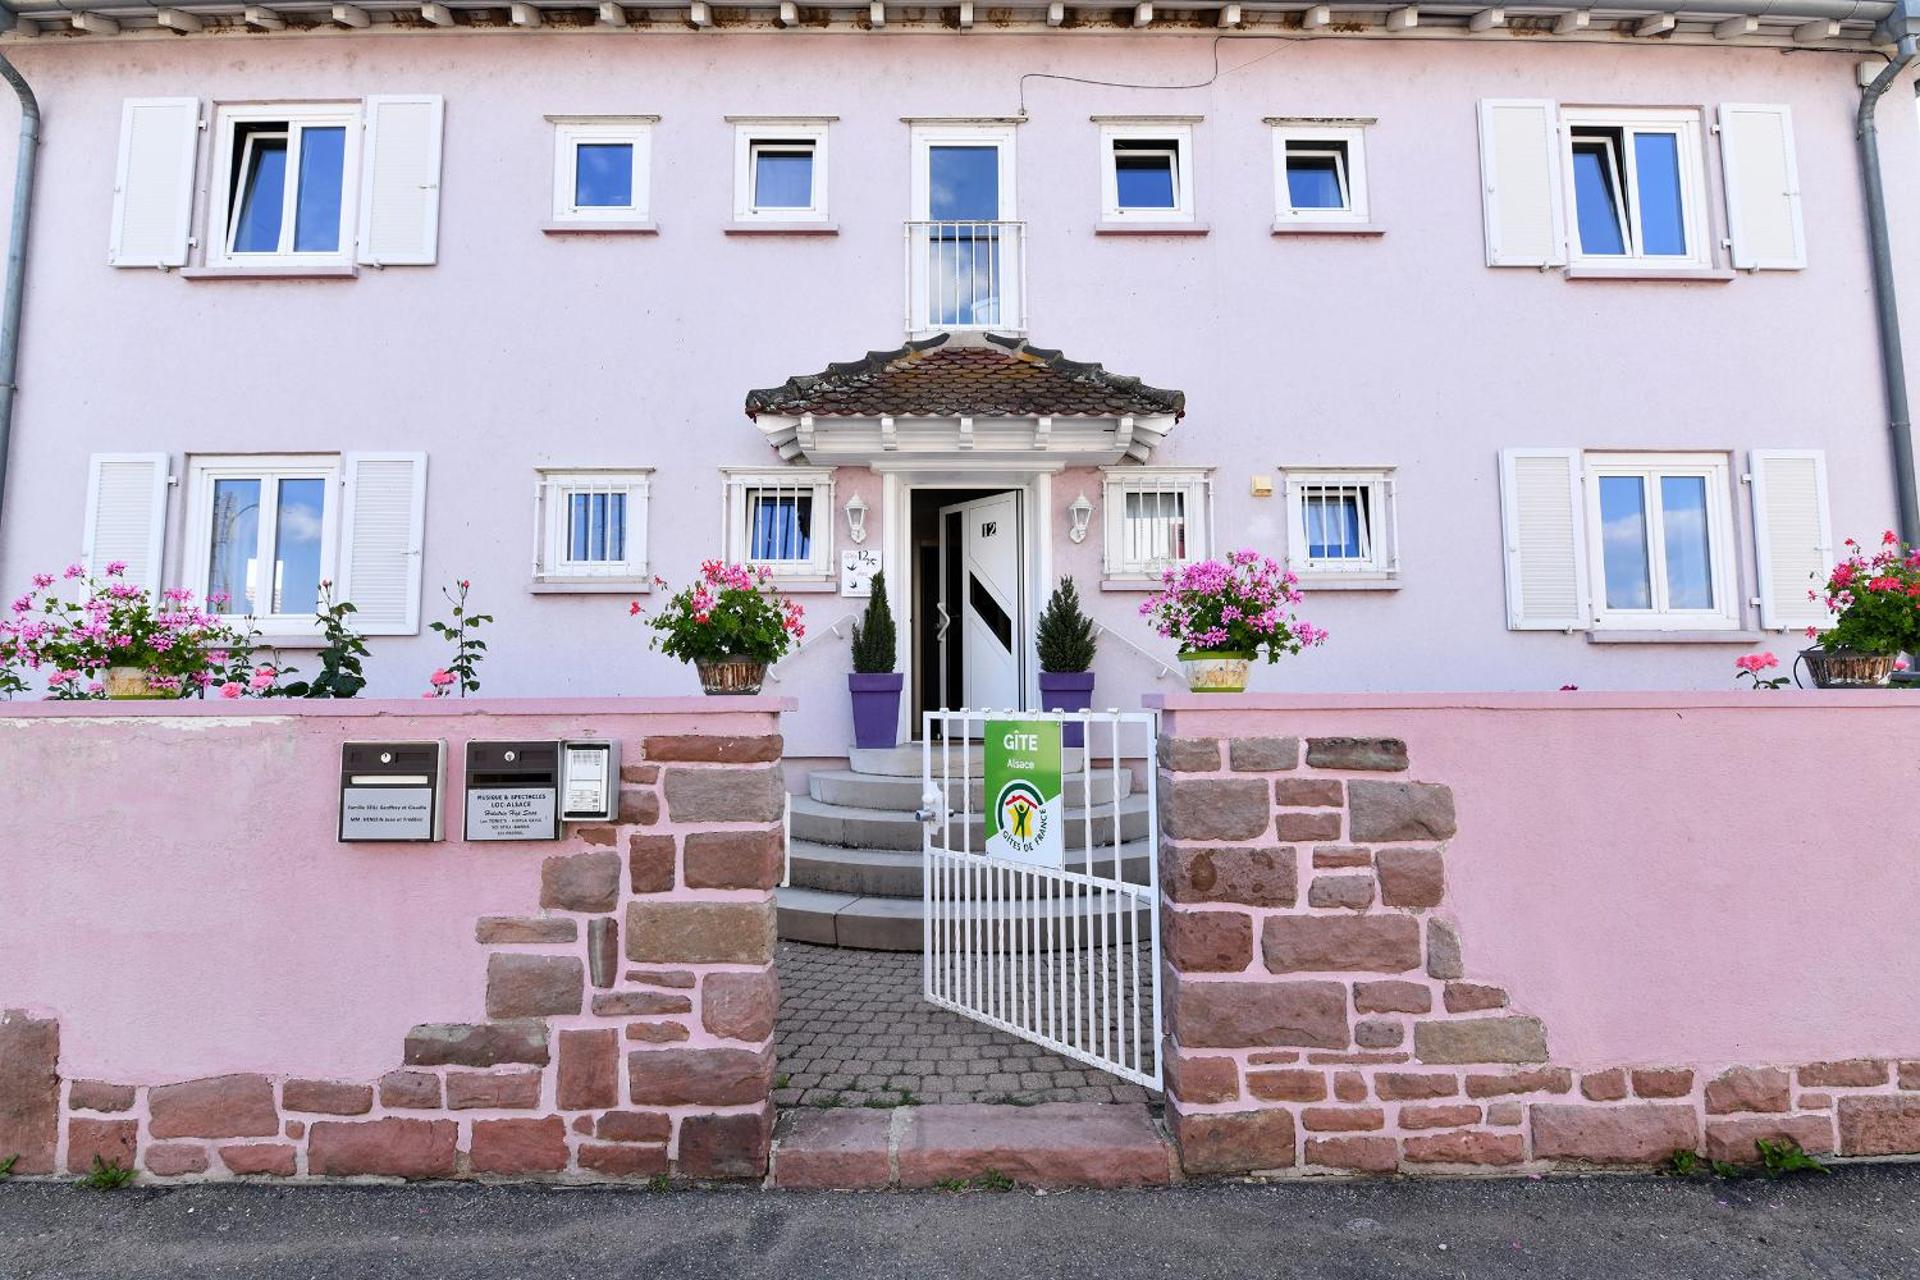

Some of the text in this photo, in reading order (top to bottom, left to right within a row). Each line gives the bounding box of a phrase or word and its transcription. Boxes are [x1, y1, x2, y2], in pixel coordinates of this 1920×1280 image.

[981, 521, 997, 538] 12
[858, 549, 869, 561] 12
[1003, 730, 1038, 751] GÎTE
[1006, 759, 1035, 769] Alsace
[1002, 808, 1048, 853] GÎTES DE FRANCE
